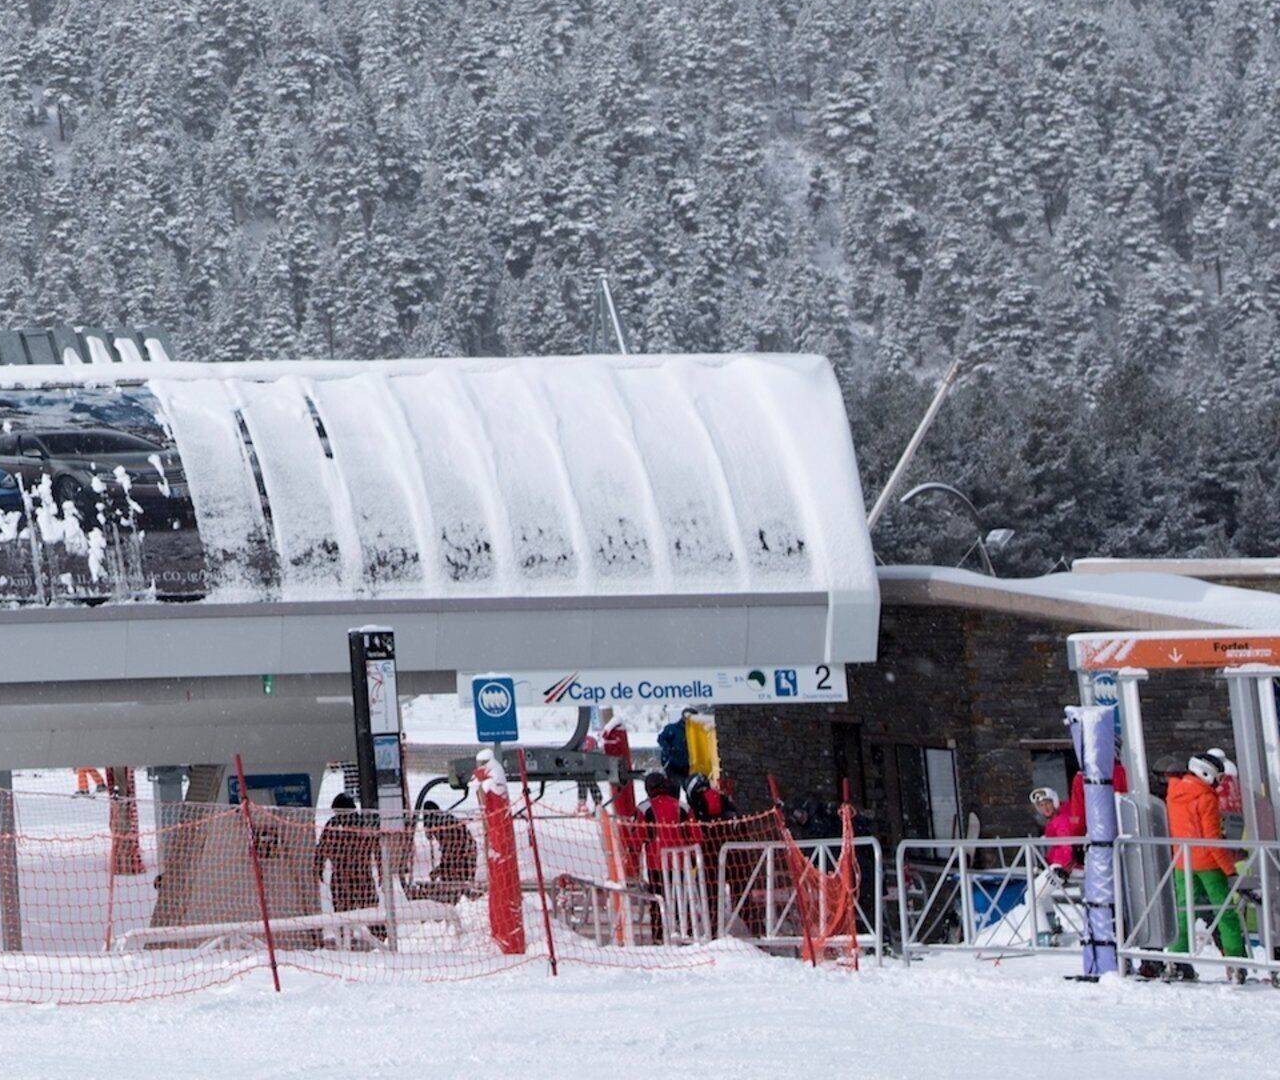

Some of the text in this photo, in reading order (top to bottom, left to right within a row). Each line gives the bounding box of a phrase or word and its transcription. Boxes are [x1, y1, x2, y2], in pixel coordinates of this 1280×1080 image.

[814, 664, 832, 690] 2
[567, 681, 605, 703] Cap
[610, 681, 633, 700] de
[637, 680, 713, 699] Comella
